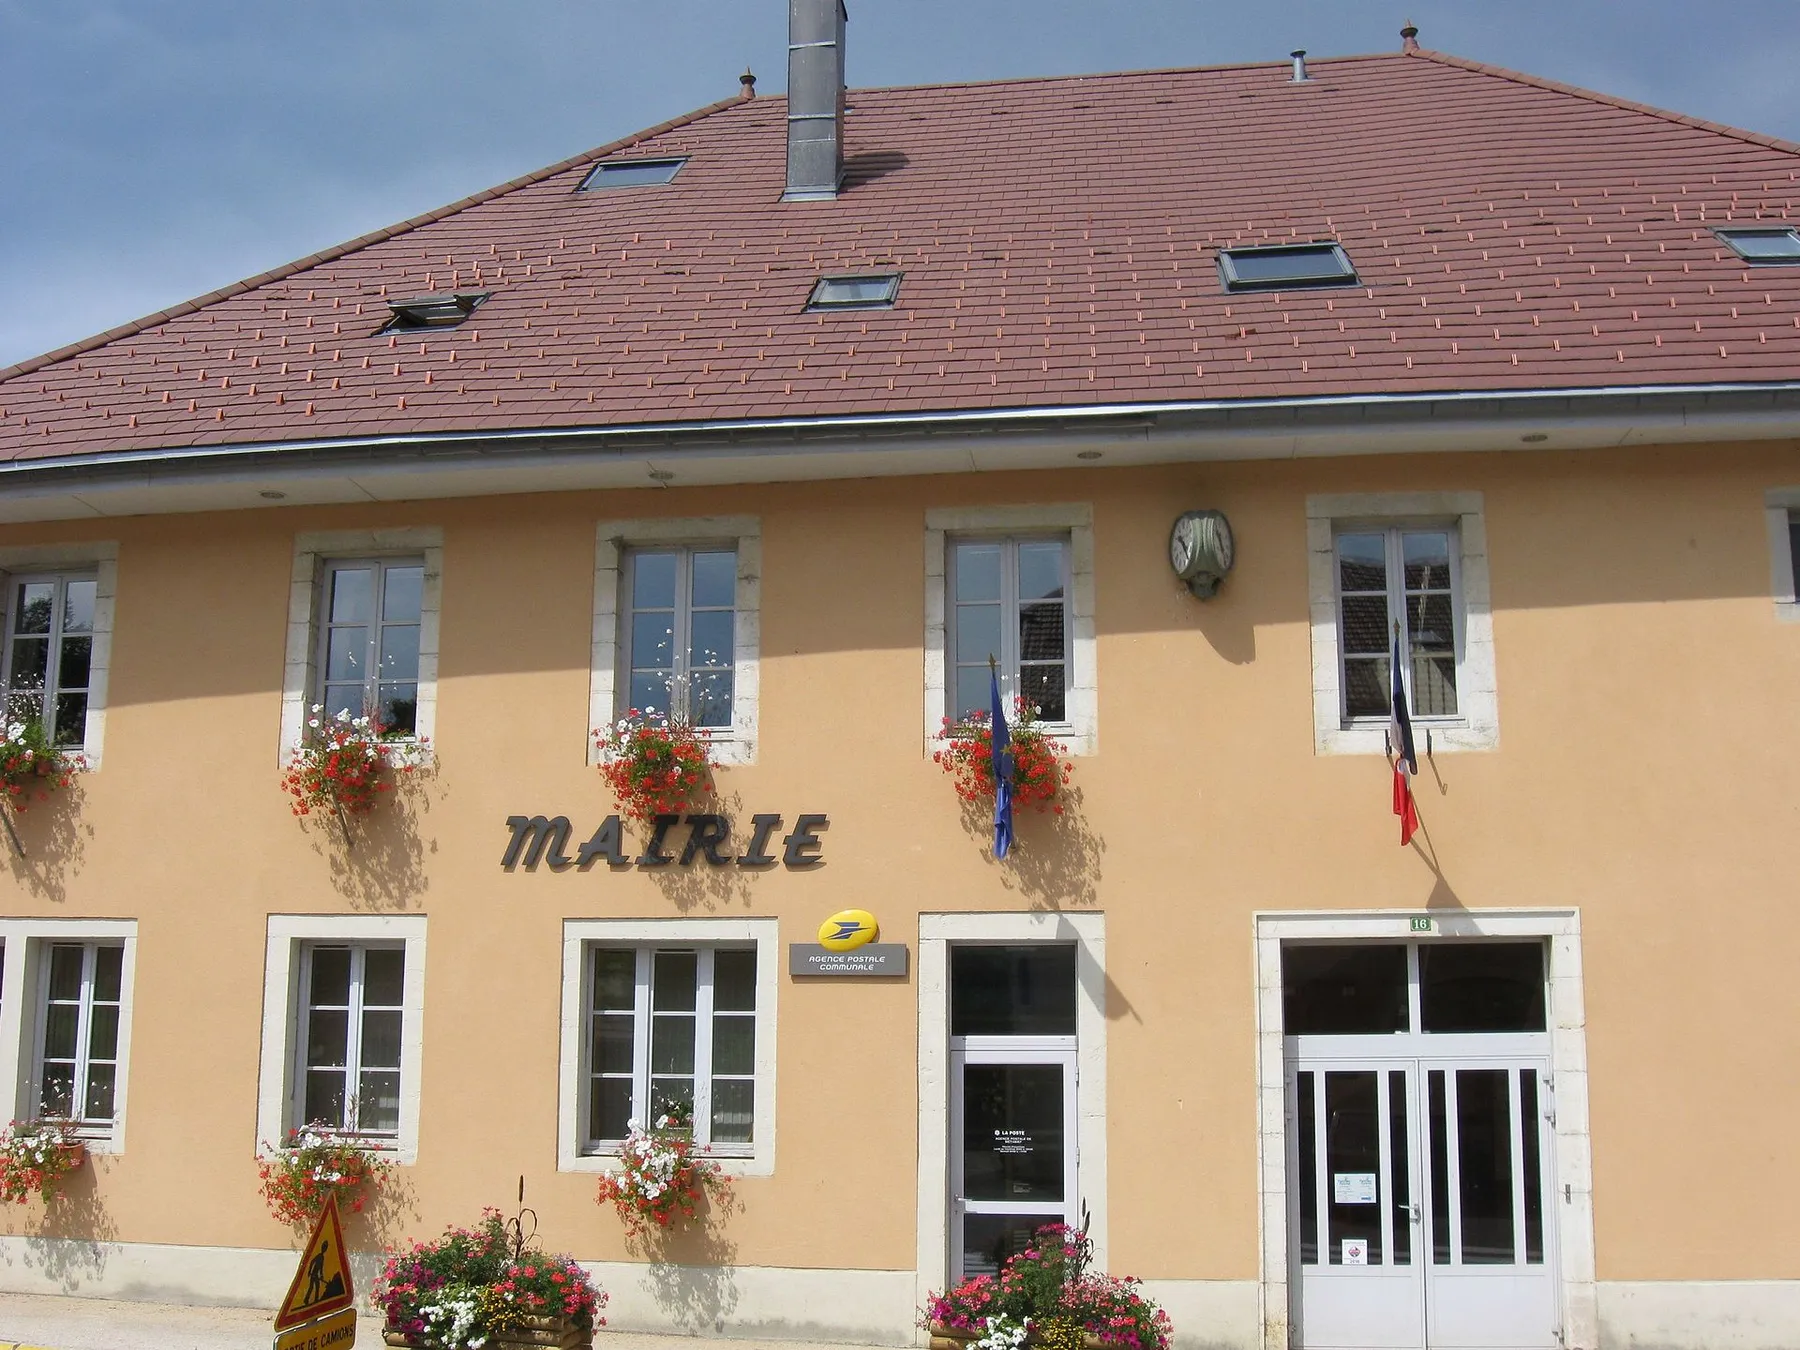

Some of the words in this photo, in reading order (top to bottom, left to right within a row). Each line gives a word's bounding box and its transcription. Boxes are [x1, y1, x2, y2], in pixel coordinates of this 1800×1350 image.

[501, 813, 828, 867] MAIRIE
[1414, 919, 1427, 929] 16
[308, 1336, 318, 1350] DE
[320, 1324, 354, 1348] CAMIONS
